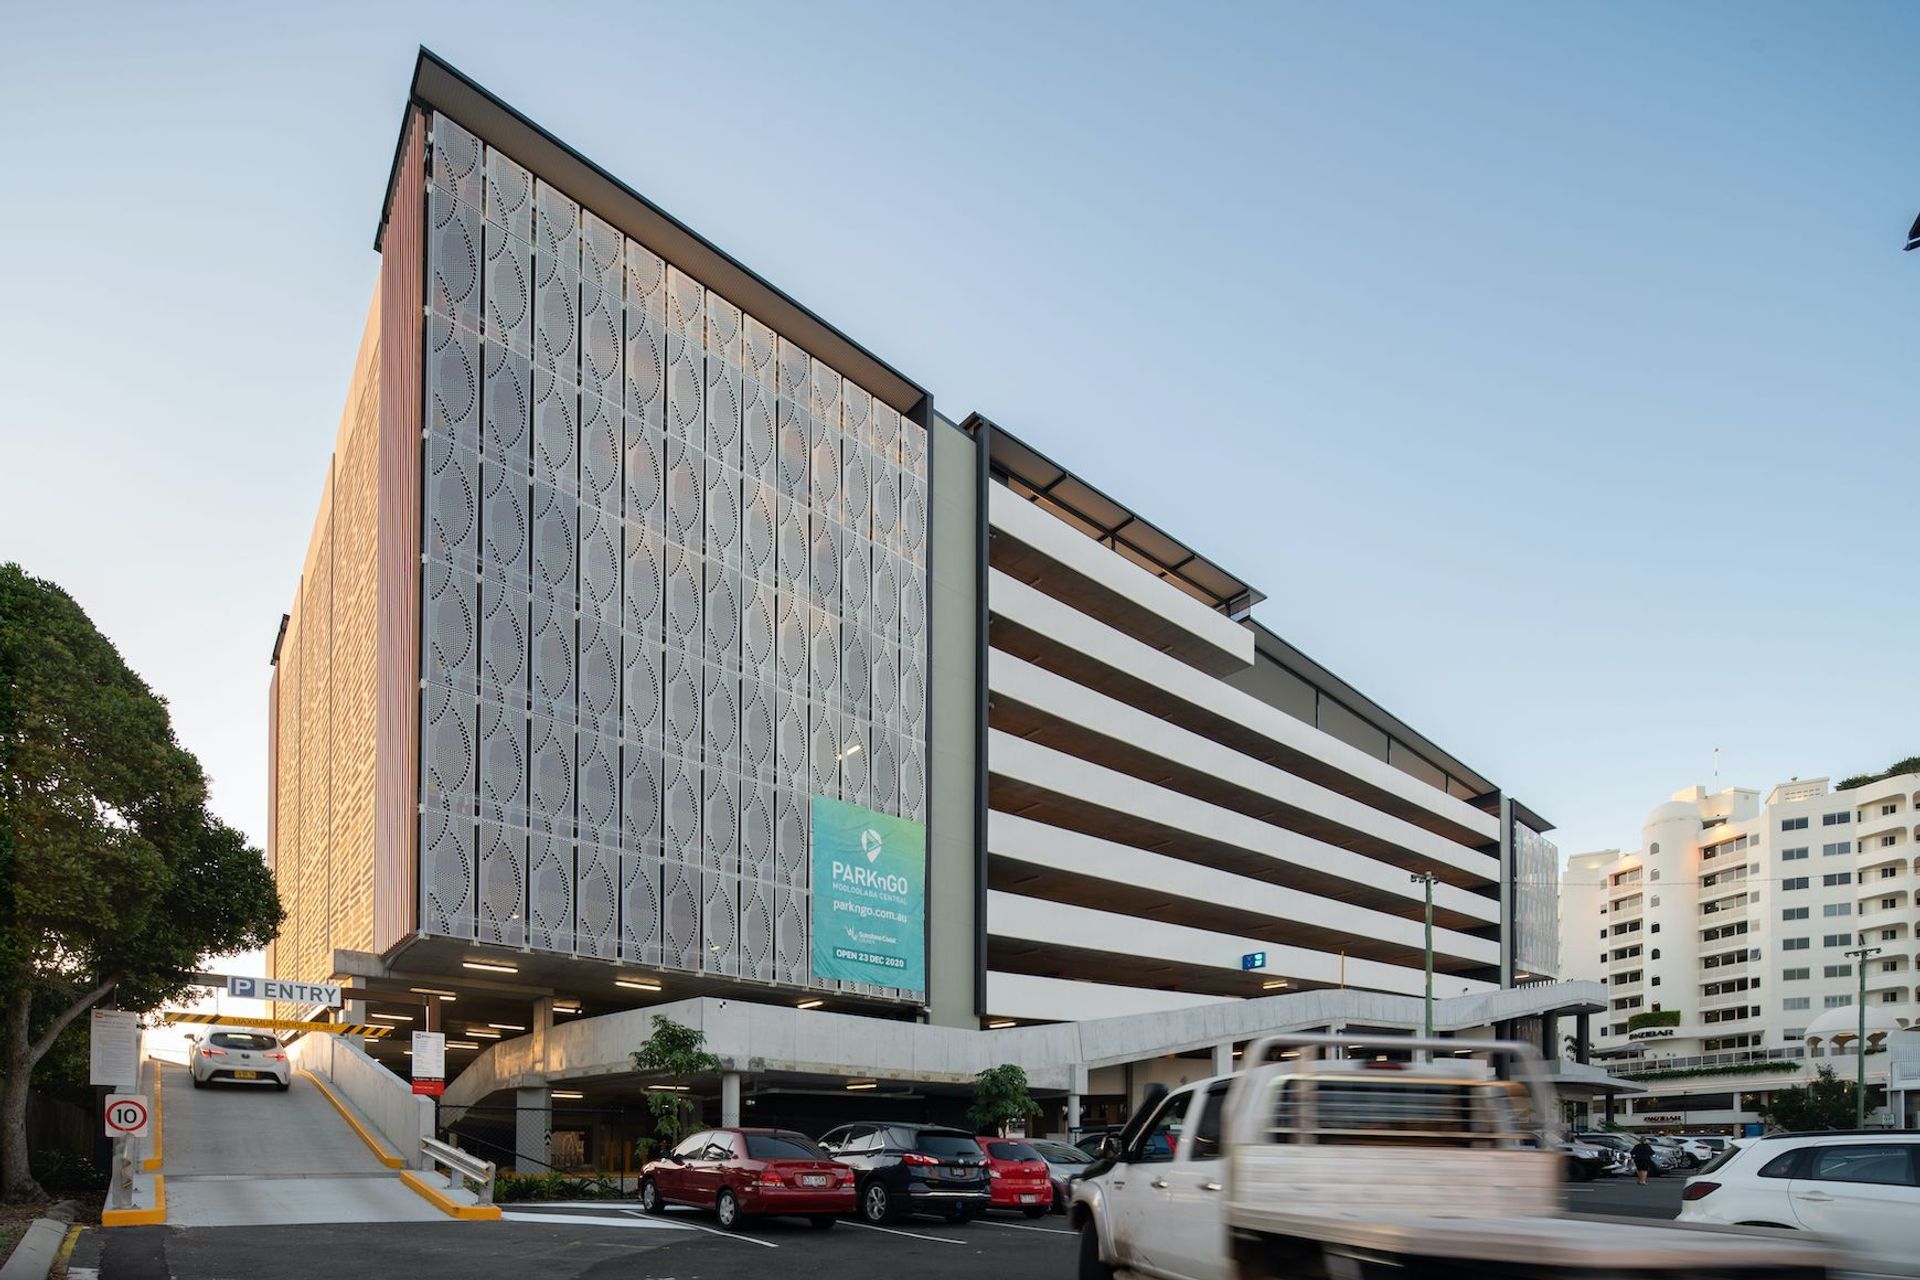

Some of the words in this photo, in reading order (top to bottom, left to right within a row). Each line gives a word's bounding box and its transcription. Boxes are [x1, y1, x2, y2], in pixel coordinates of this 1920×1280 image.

[832, 861, 908, 895] PARKnGO
[832, 882, 878, 897] MOOLOOLABA
[879, 892, 908, 905] CENTRAL
[833, 900, 907, 923] parkngo.com.au
[836, 948, 858, 960] OPEN
[858, 952, 869, 962] 23
[869, 954, 885, 965] DEC
[885, 957, 905, 968] 2020
[264, 982, 337, 1003] ENTRY
[233, 1017, 277, 1027] MAXIMUM
[278, 1020, 312, 1030] HEIGHT
[116, 1108, 137, 1125] 10
